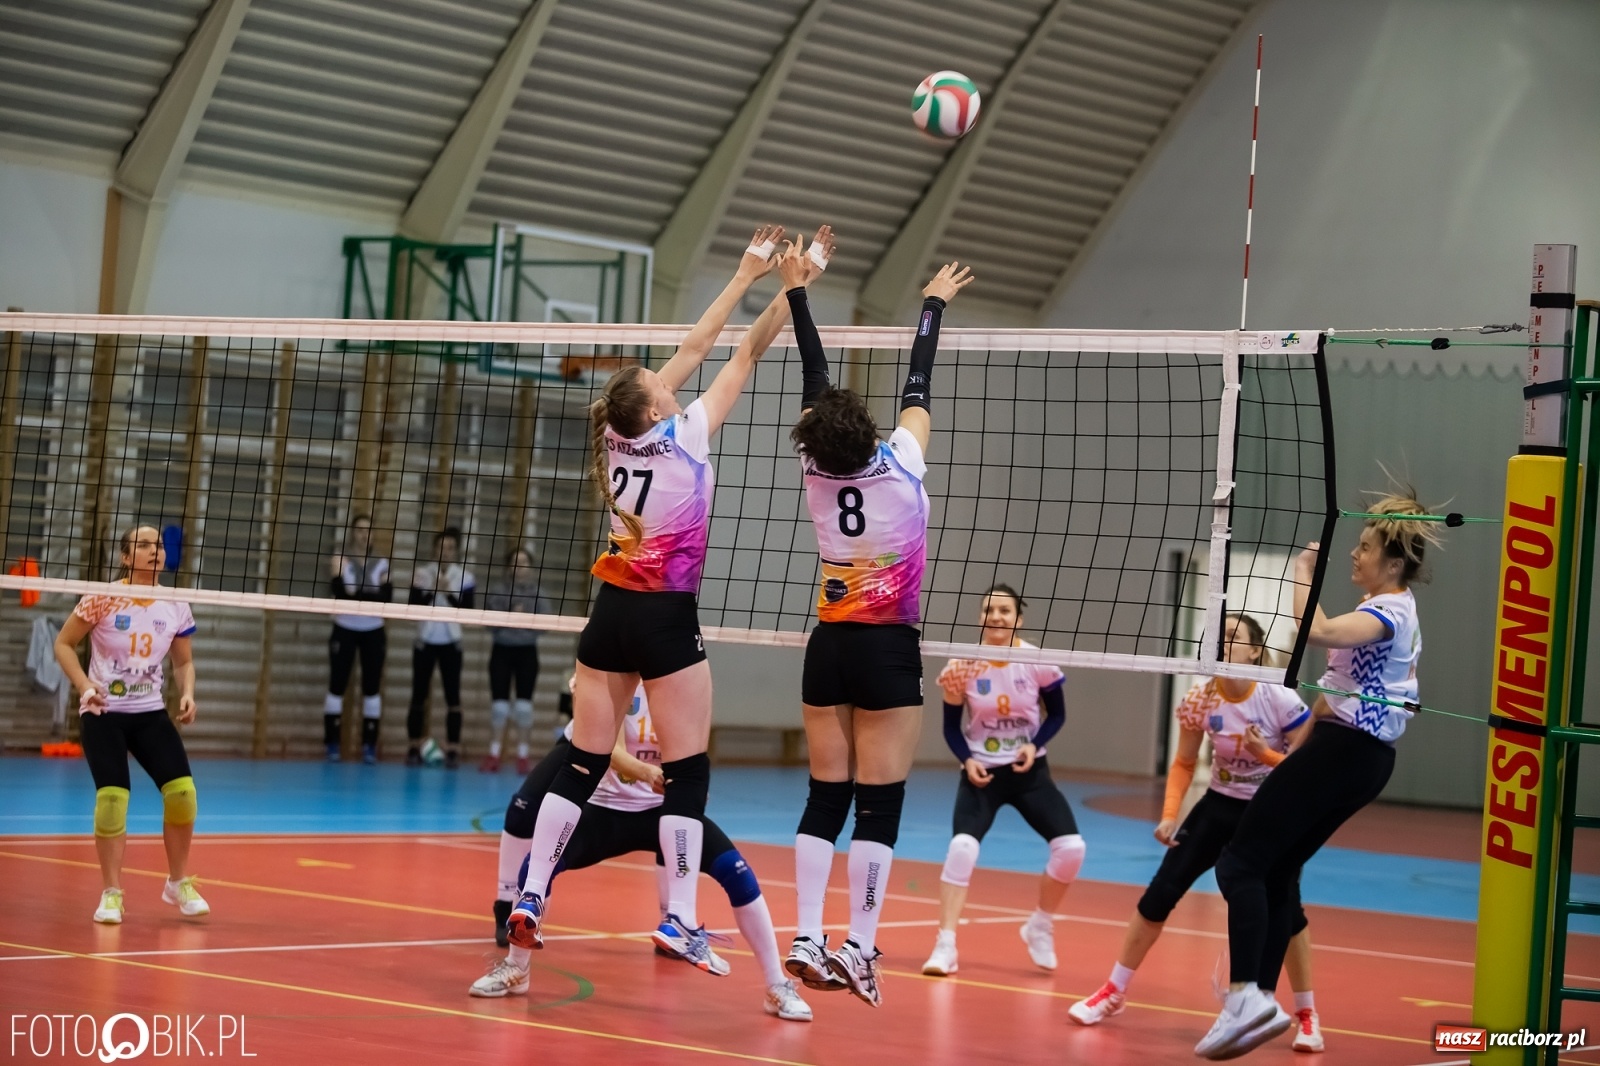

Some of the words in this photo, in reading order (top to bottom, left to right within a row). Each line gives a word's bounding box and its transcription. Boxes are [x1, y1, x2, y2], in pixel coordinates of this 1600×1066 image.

[1531, 264, 1544, 411] PEMENPL
[612, 466, 653, 517] 27
[838, 486, 866, 537] 8
[129, 632, 153, 659] 13
[997, 694, 1010, 717] 8
[1486, 495, 1556, 869] PESMENPOL
[1230, 733, 1244, 756] 7
